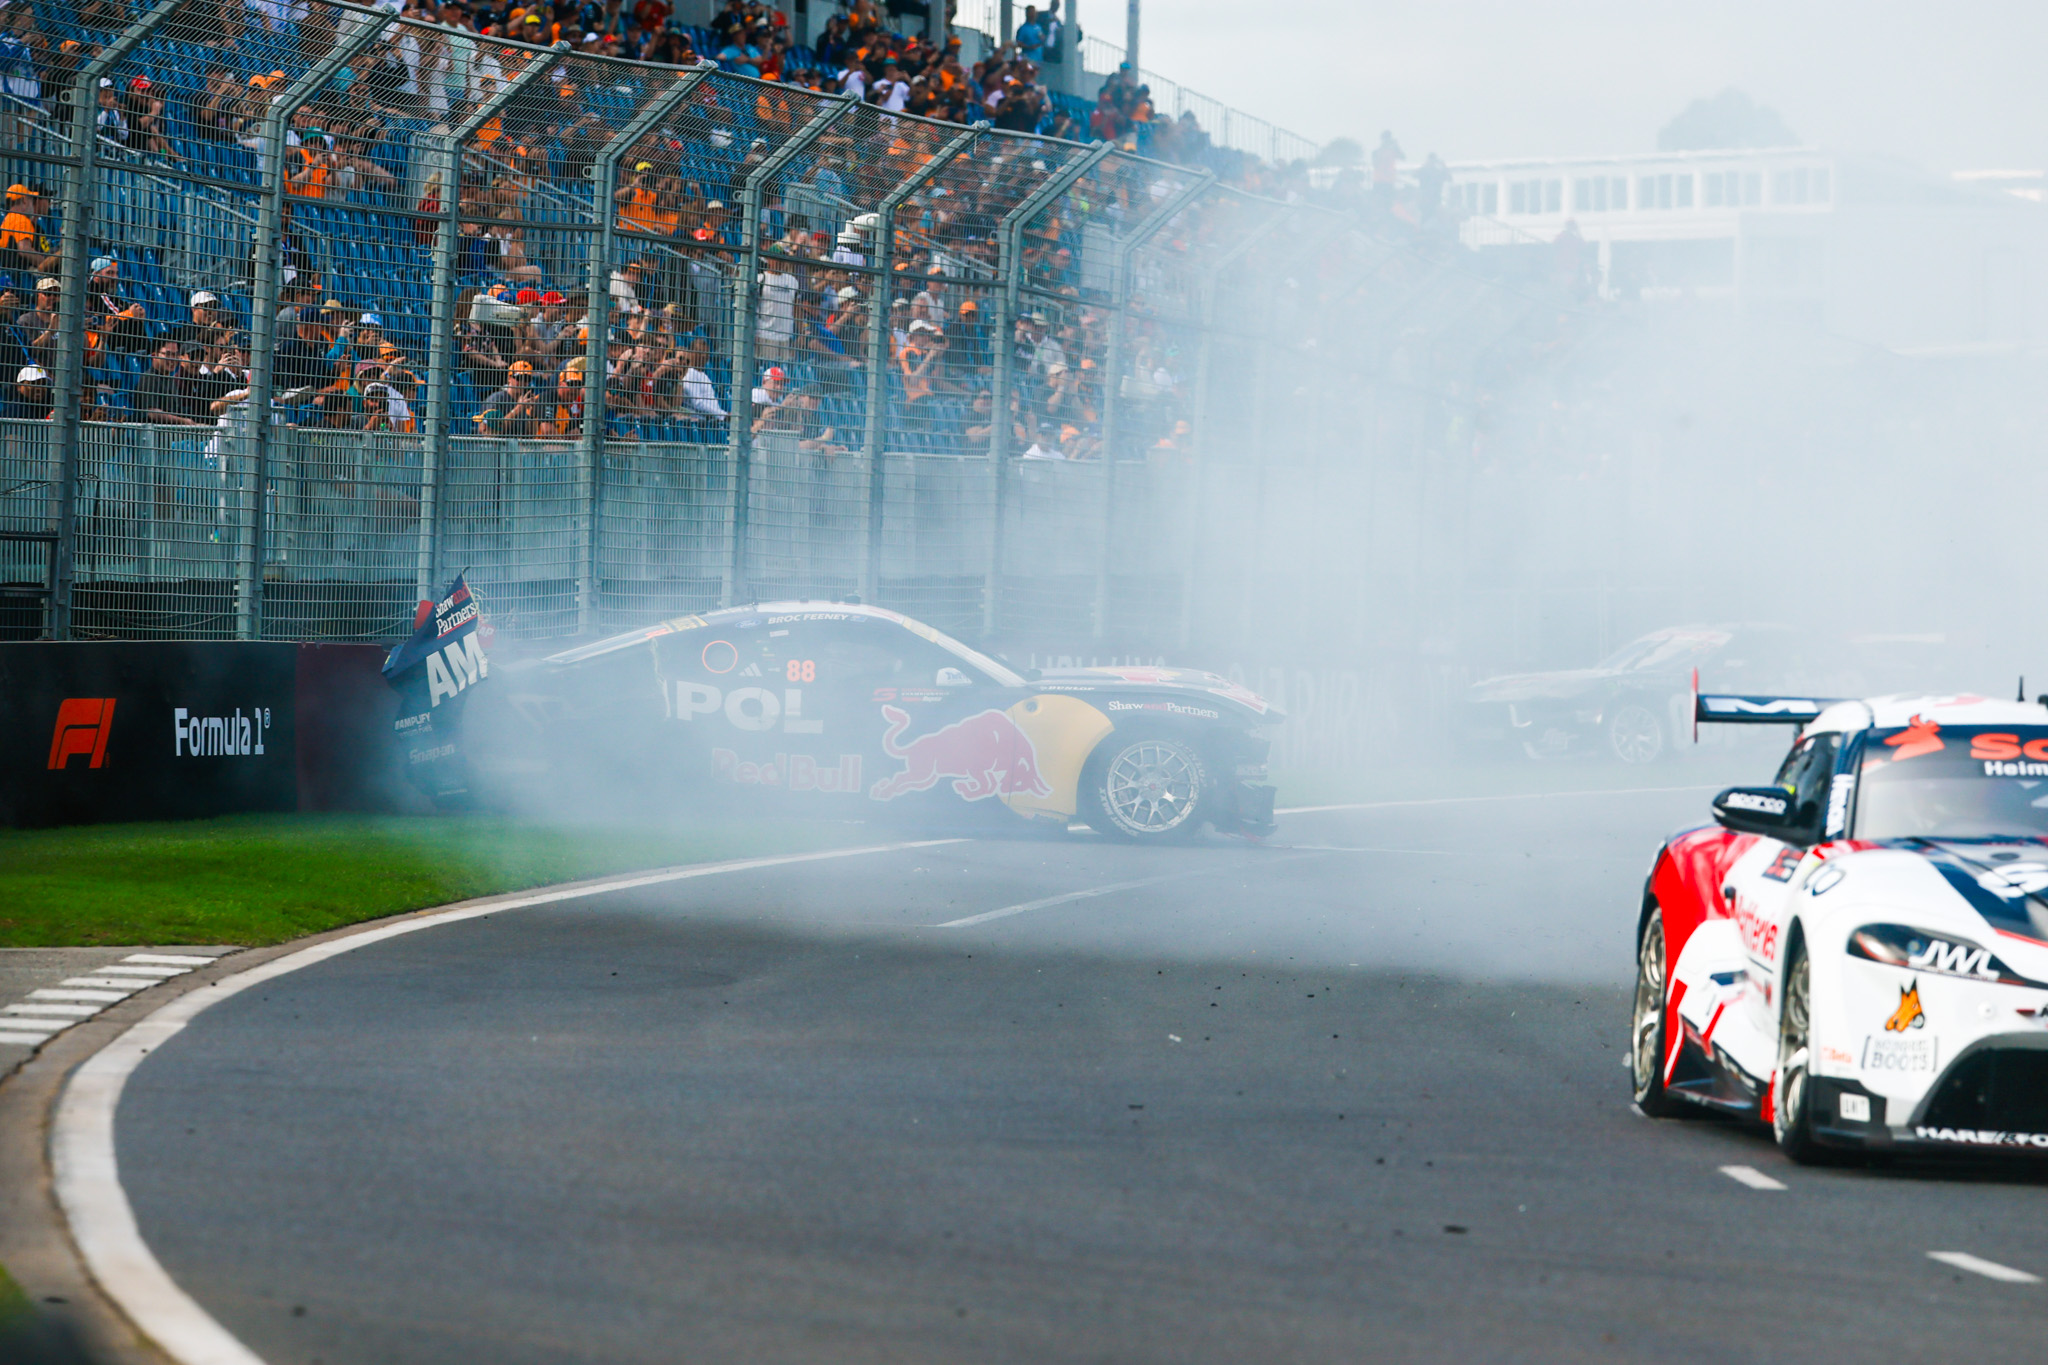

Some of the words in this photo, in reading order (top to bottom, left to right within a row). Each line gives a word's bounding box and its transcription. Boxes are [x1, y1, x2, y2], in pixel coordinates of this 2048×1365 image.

[436, 603, 477, 637] Partners
[768, 614, 800, 624] BROC
[802, 613, 849, 622] FEENEY
[425, 631, 488, 708] AM
[787, 659, 815, 683] 88
[174, 707, 251, 757] Formula
[400, 712, 431, 729] AMPLIFY
[409, 744, 455, 764] Snap-on
[712, 747, 787, 786] Red
[789, 754, 863, 793] Bull
[1908, 940, 2000, 979] JWL
